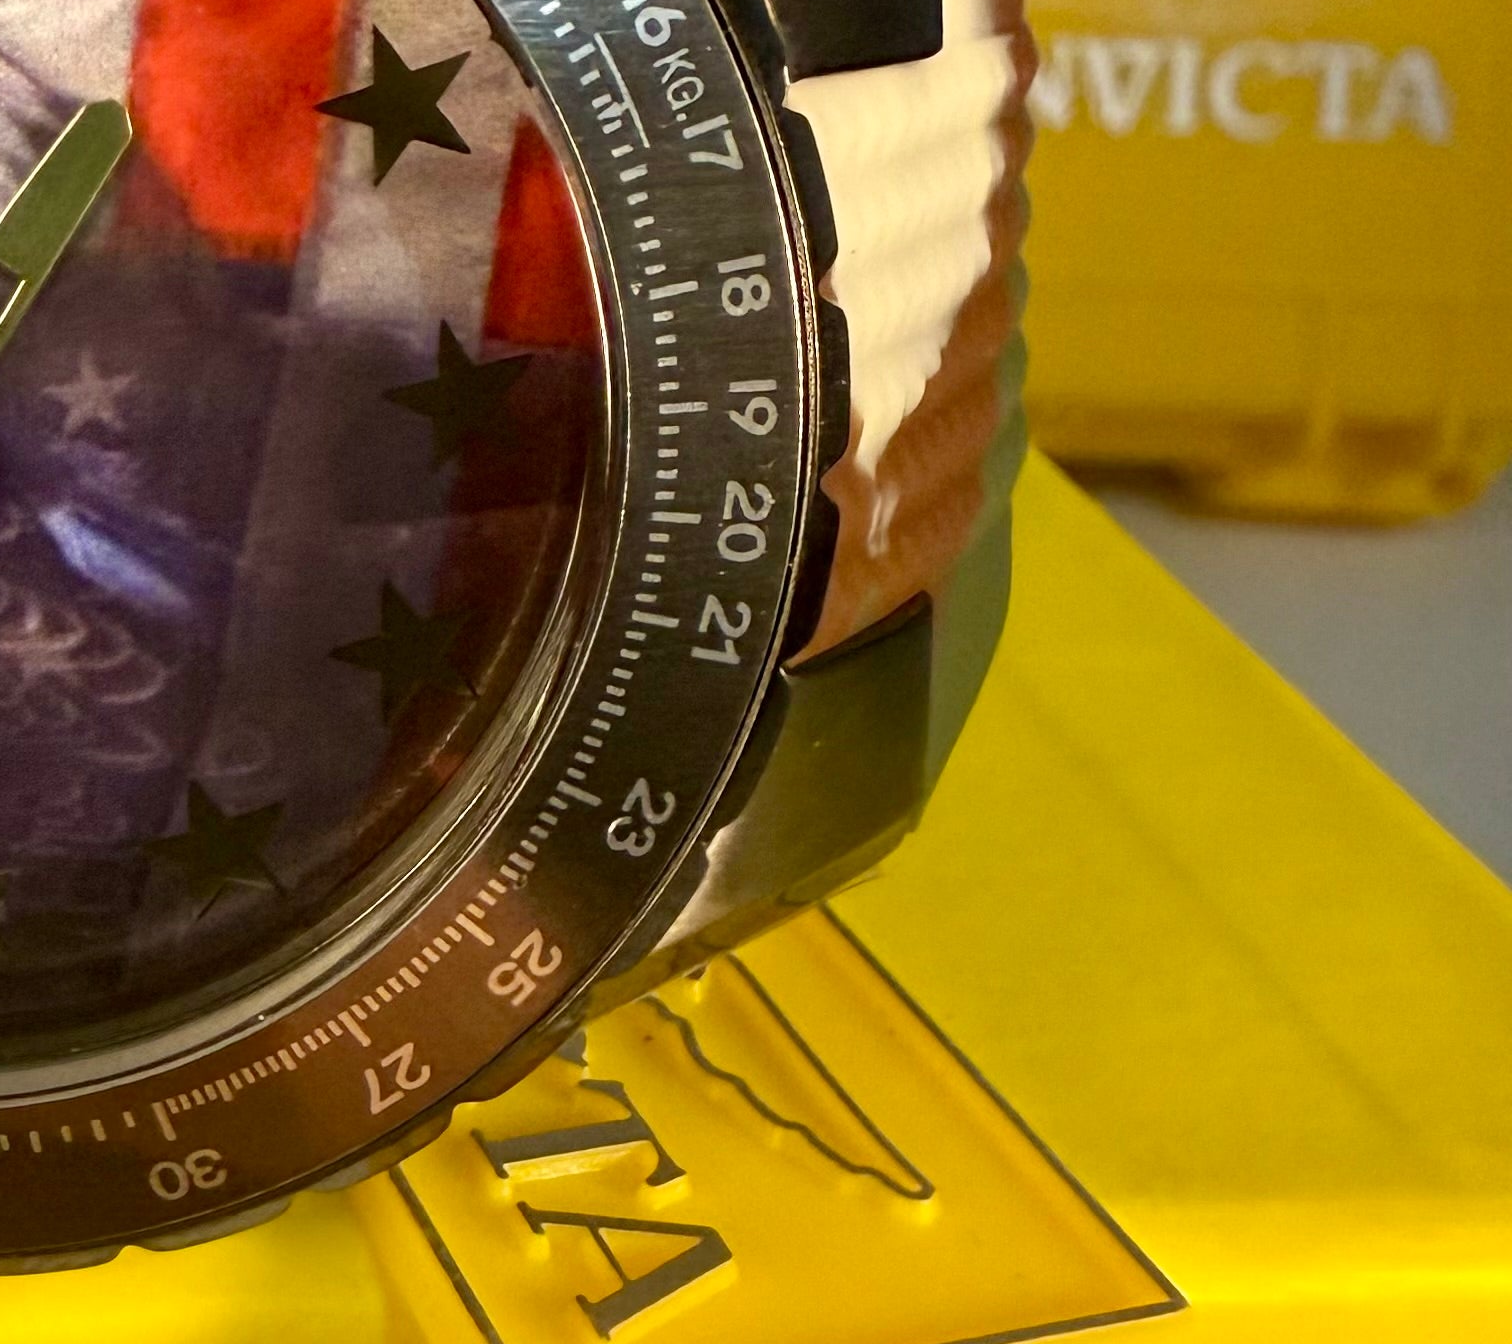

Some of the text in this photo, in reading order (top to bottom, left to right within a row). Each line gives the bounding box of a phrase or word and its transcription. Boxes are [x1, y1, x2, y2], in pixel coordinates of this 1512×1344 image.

[653, 48, 704, 122] KG.
[1028, 32, 1453, 146] NVICTA
[683, 114, 744, 170] 17
[717, 254, 771, 317] 18
[728, 379, 778, 436] 19
[717, 481, 775, 562] 20
[691, 594, 752, 665] 21
[607, 777, 676, 856] 23
[487, 928, 563, 1007] 25
[364, 1042, 431, 1115] 27
[149, 1148, 227, 1200] 30
